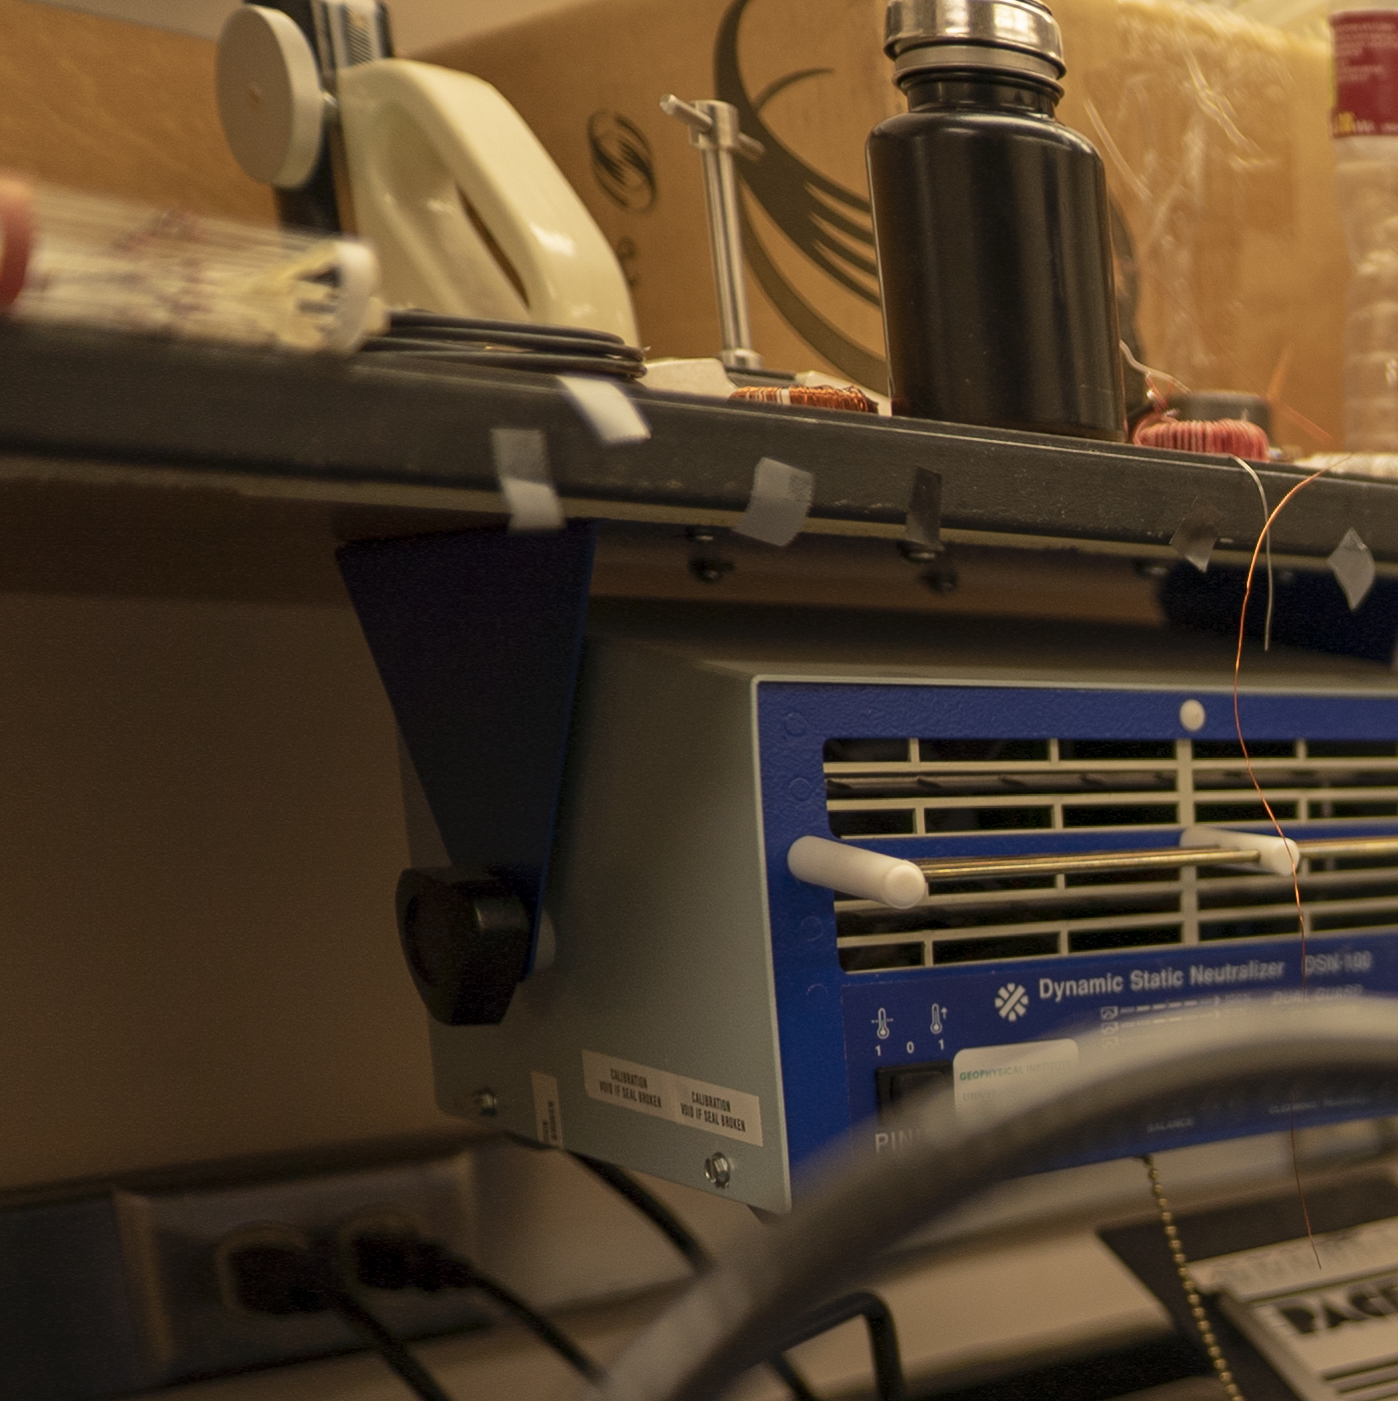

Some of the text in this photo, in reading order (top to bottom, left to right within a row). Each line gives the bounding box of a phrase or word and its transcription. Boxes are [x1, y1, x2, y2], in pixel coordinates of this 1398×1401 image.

[1039, 971, 1124, 1003] Dynamic
[1130, 967, 1184, 991] Static
[1190, 959, 1285, 985] Neutralizer
[906, 1041, 915, 1054] 0
[610, 1068, 648, 1090] CALIBRATION
[959, 1064, 1023, 1081] GEOPHYSICAL
[599, 1080, 662, 1108] VOID IF SEAL BROKEN
[691, 1091, 731, 1113] CALIBRATION
[680, 1102, 746, 1132] VOID IF SEAL BROKEN
